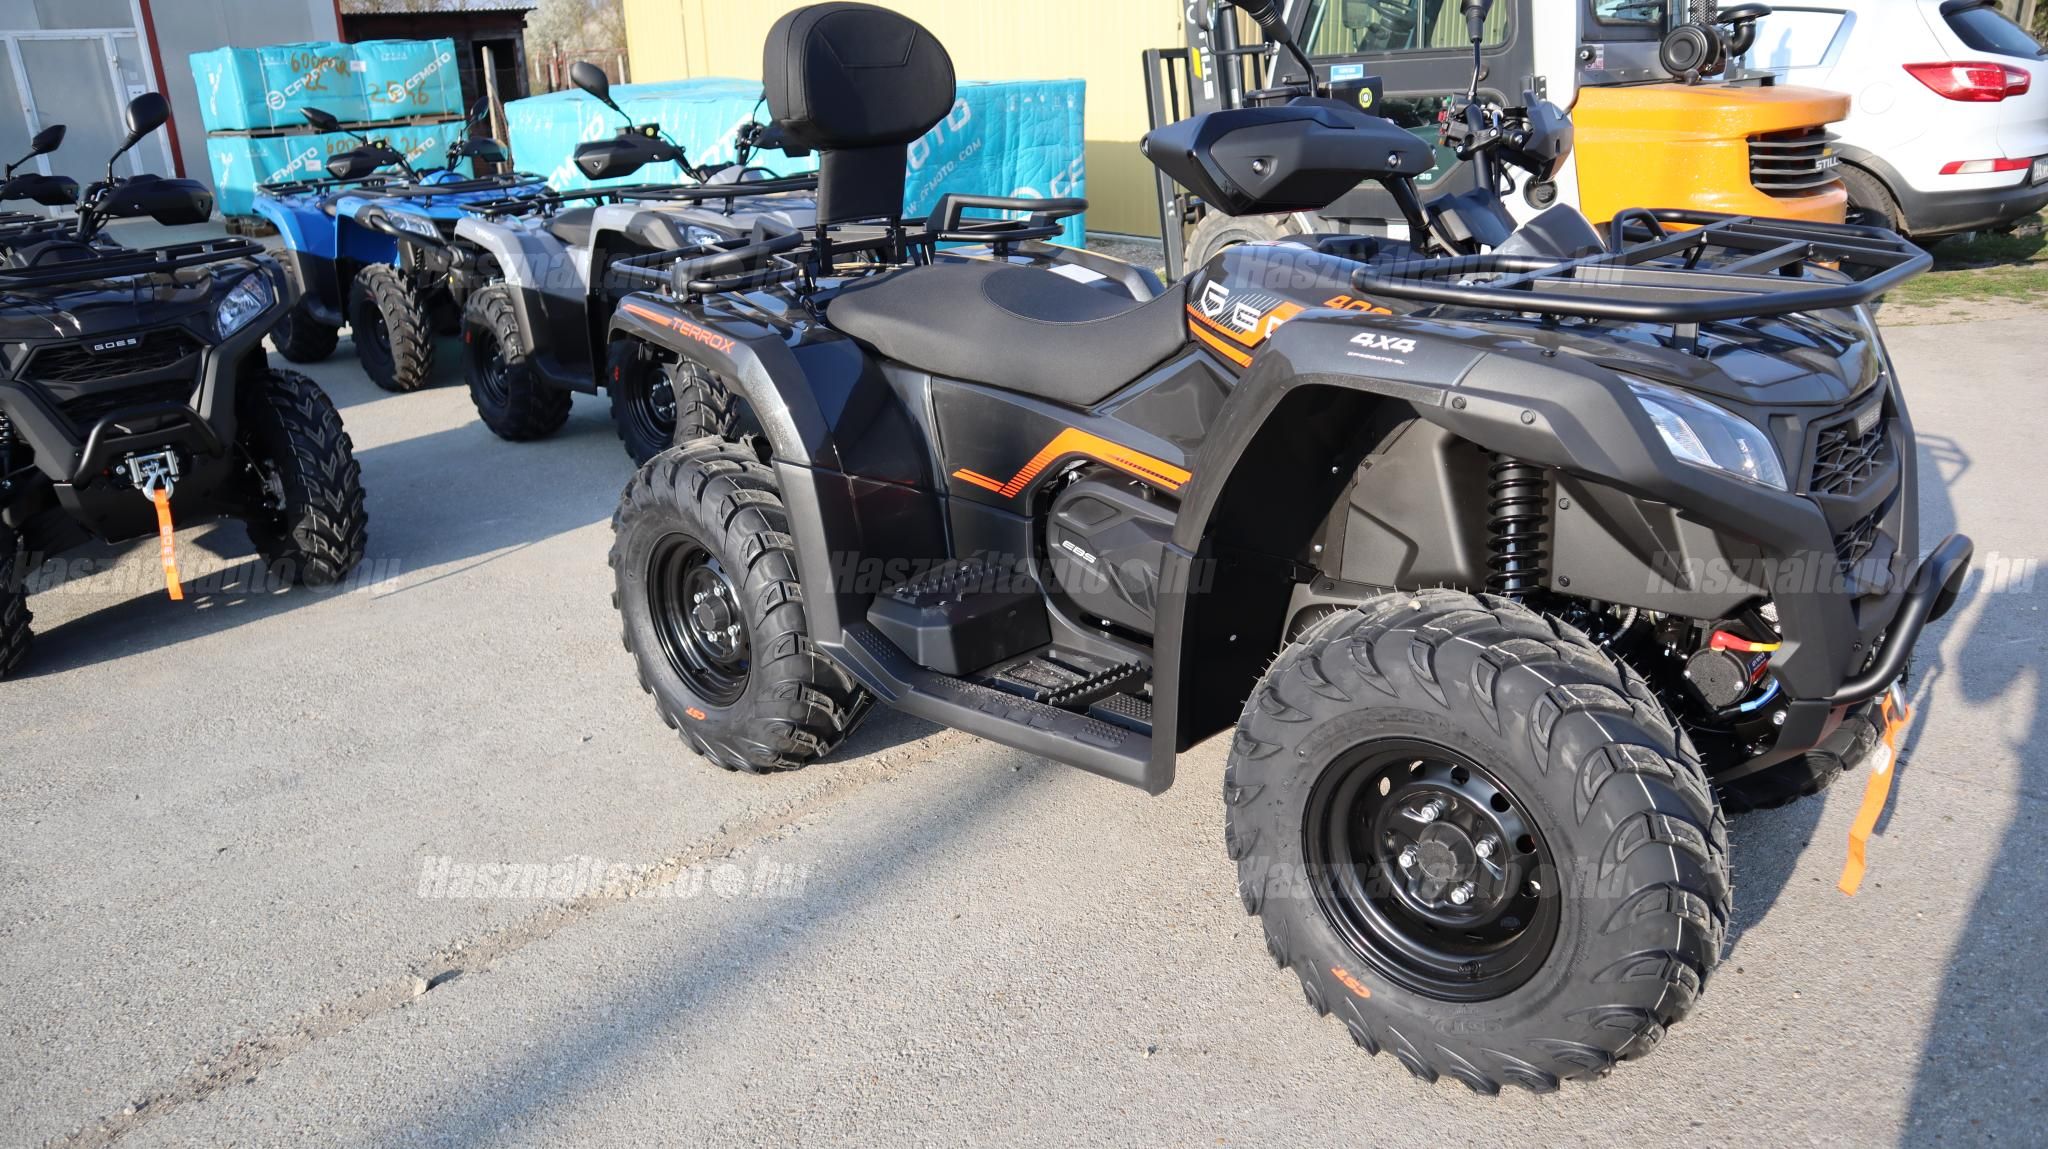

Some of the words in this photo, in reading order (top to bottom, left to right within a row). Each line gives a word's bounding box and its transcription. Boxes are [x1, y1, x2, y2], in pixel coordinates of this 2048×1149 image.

[406, 52, 451, 90] CFMOTO
[1816, 156, 1839, 171] STILL
[94, 338, 137, 351] GOES
[672, 317, 736, 354] TERROX
[1062, 540, 1097, 563] EBS
[1330, 966, 1371, 999] CST
